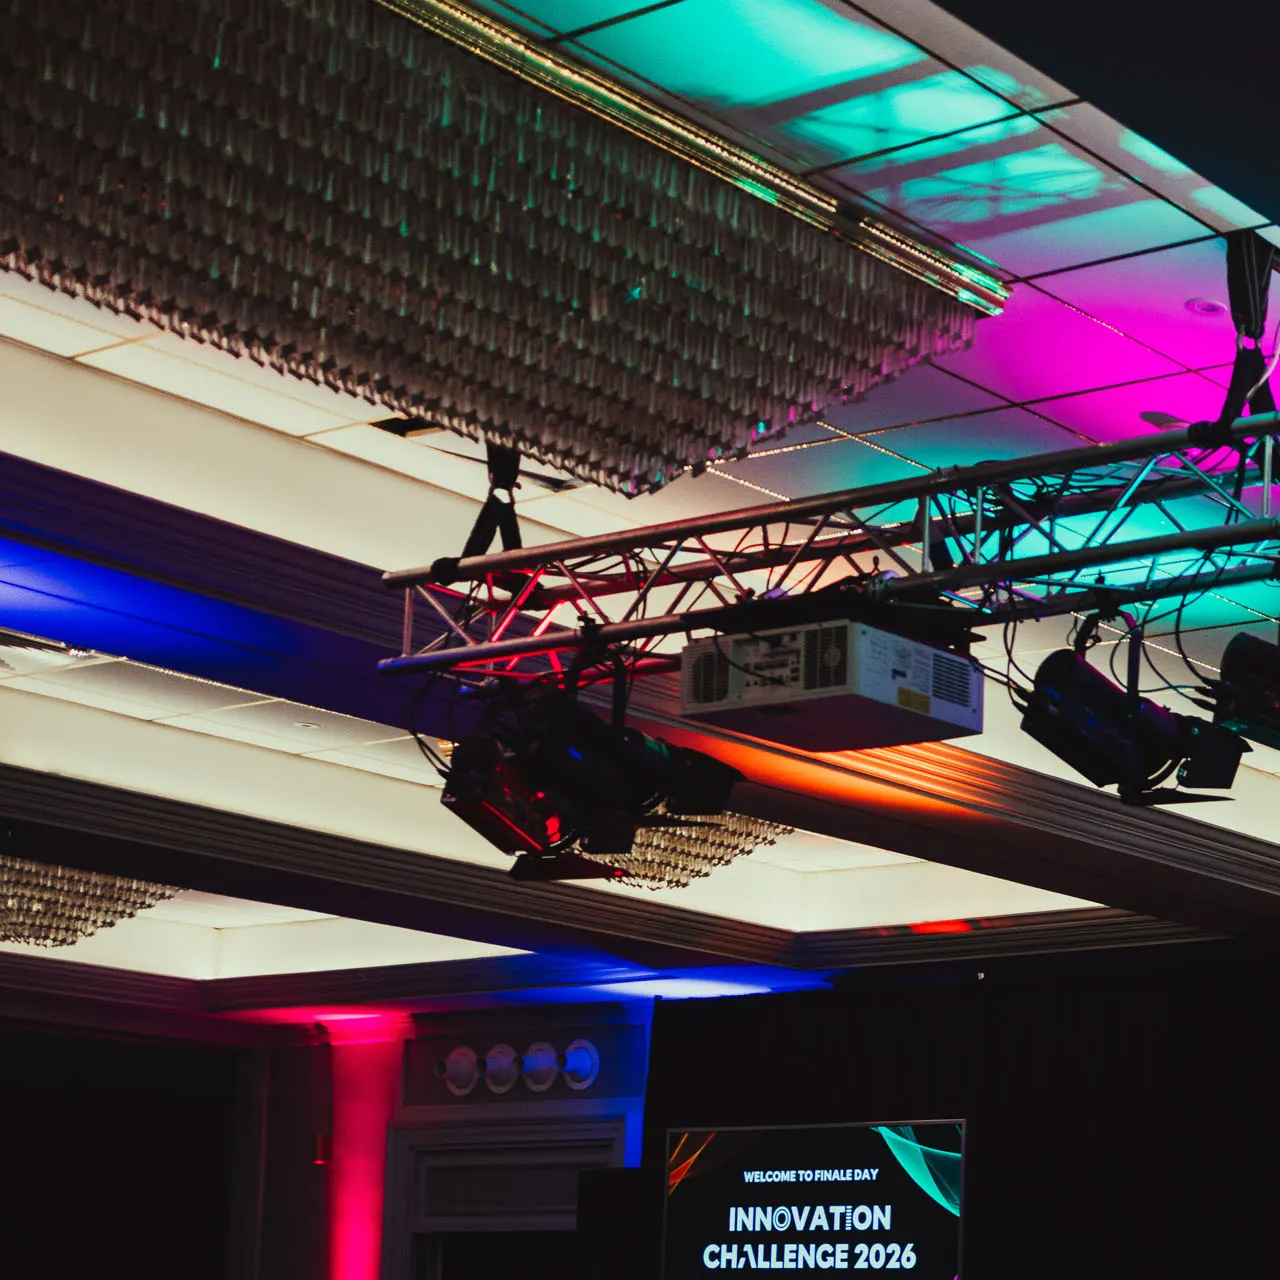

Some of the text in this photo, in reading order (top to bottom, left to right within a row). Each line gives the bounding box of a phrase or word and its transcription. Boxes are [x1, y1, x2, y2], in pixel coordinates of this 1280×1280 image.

[744, 1169, 879, 1182] WELCOME TO FINALE DAY
[729, 1205, 891, 1231] INNOVATION
[703, 1243, 916, 1269] CHALLENGE 2026
